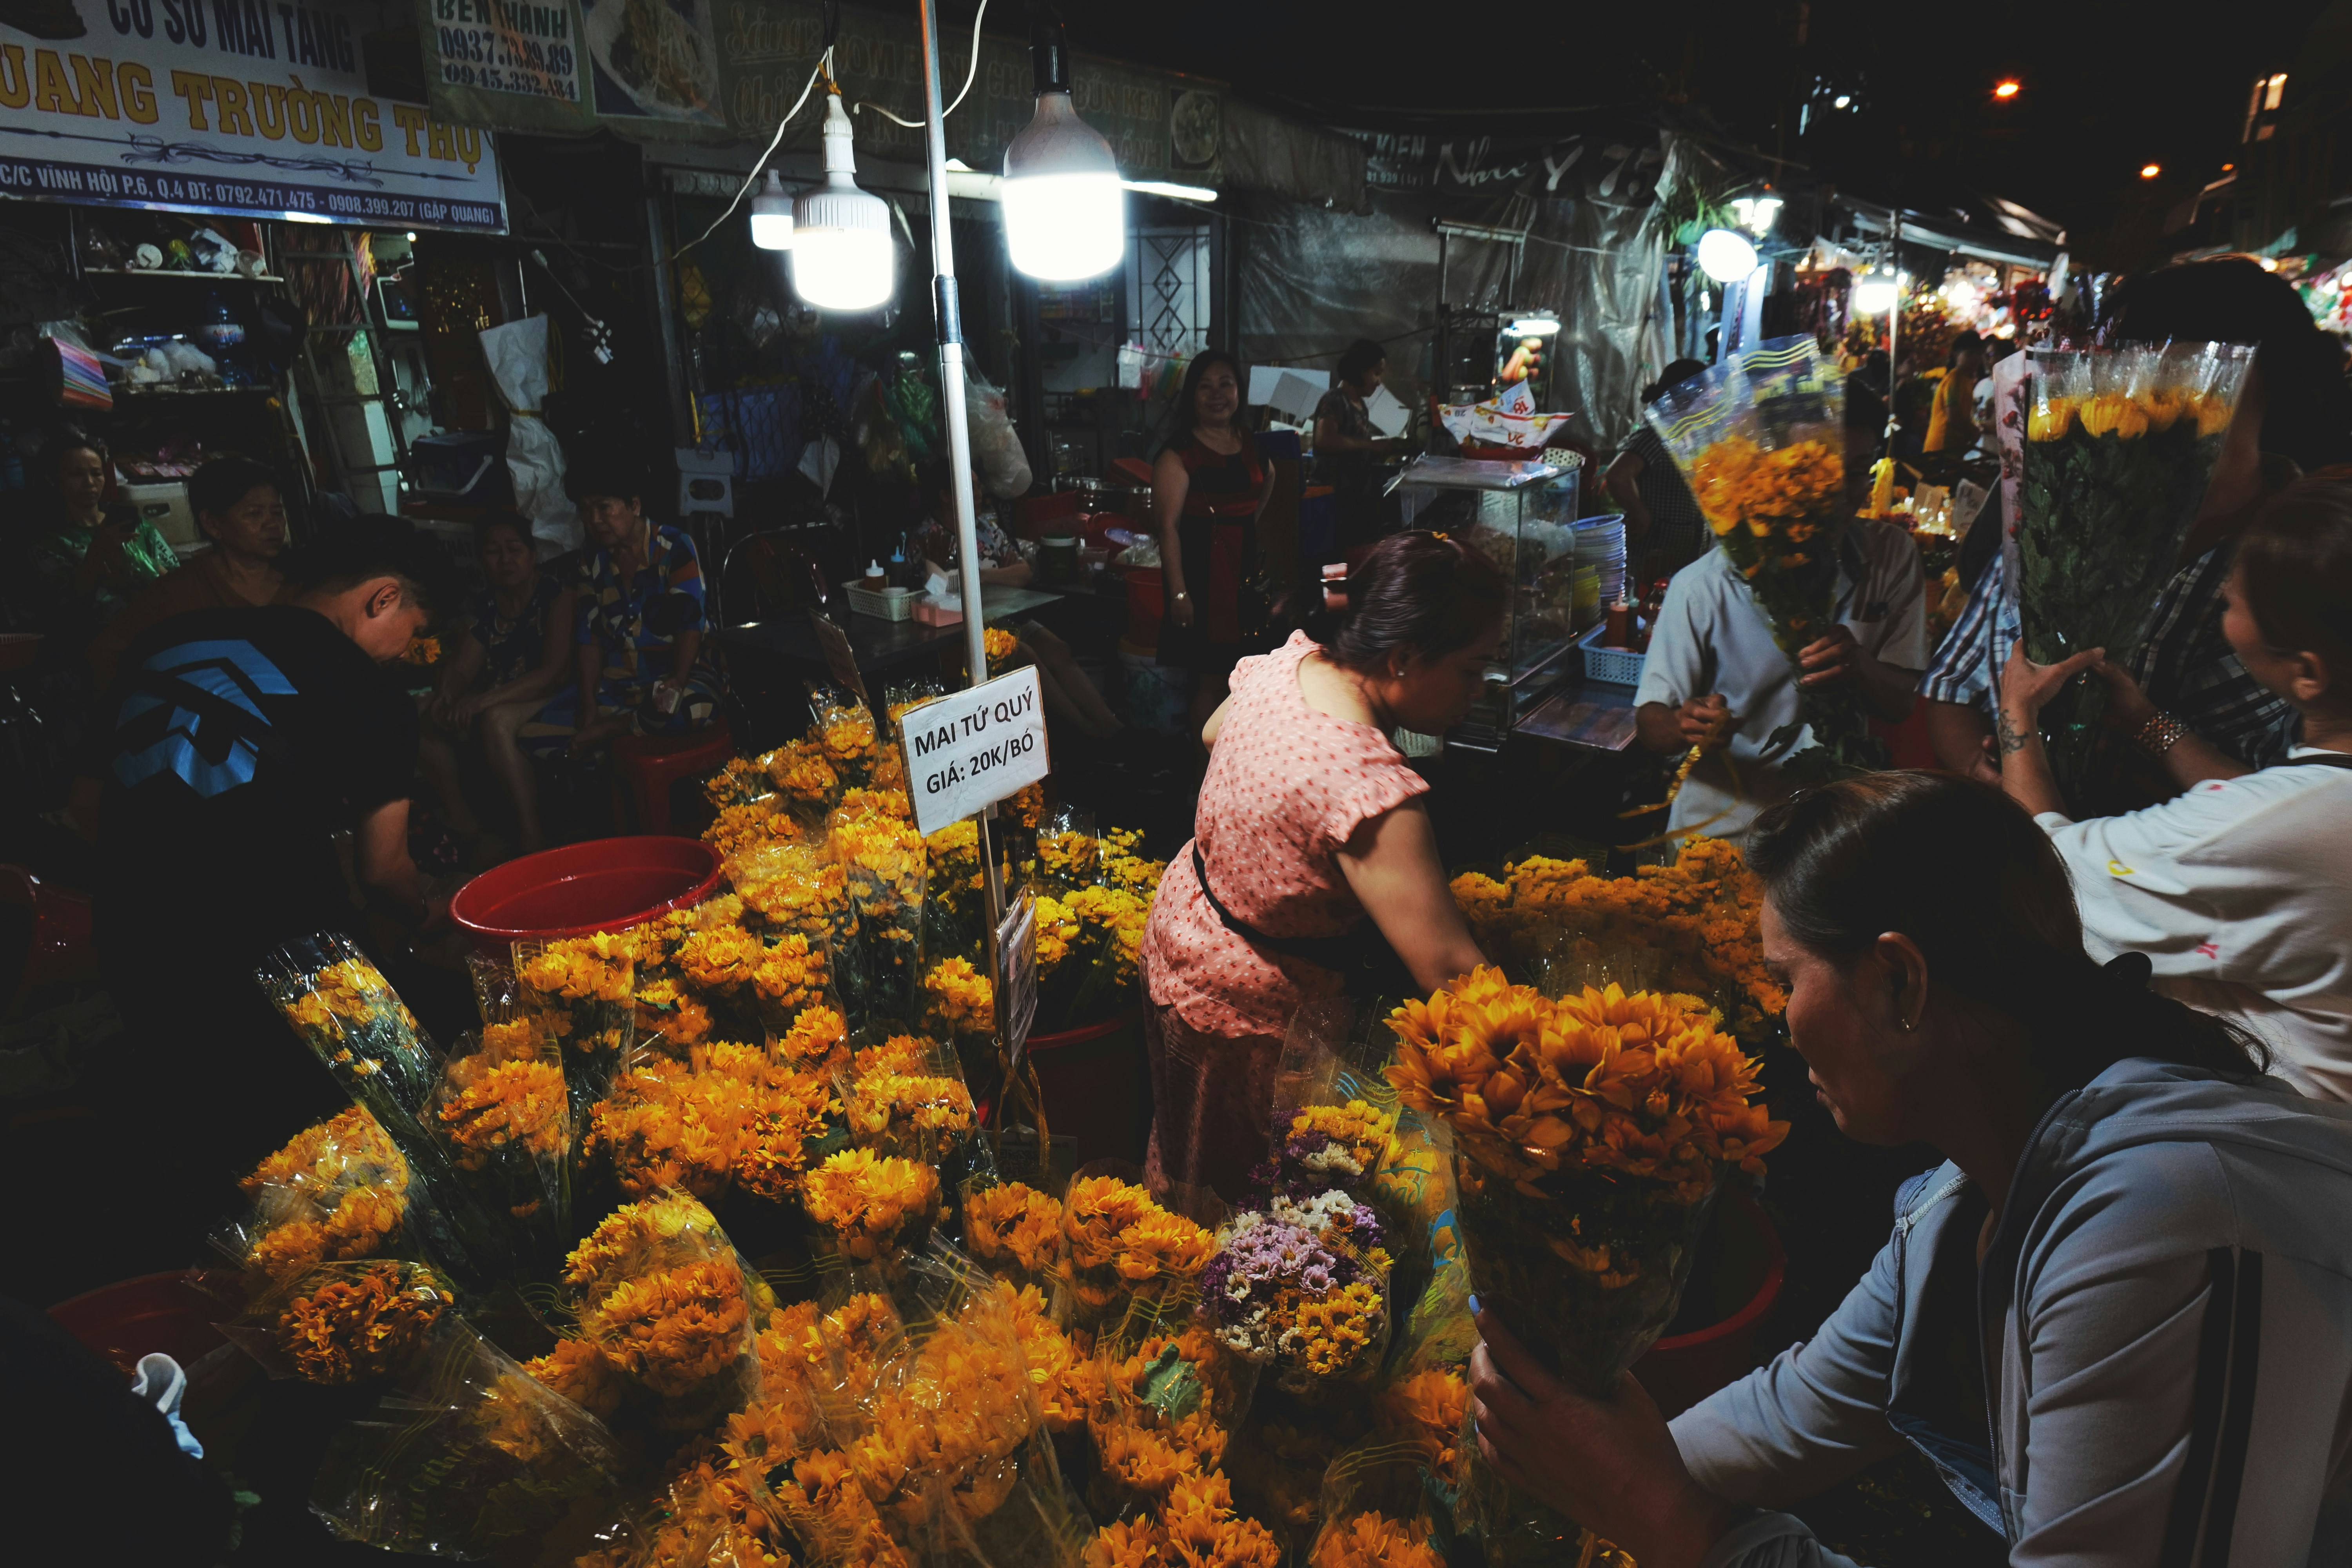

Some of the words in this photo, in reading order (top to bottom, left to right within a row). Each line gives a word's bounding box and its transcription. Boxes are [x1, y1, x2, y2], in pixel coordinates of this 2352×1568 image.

[213, 0, 276, 59] MAI
[277, 0, 356, 73] TÁNG
[440, 26, 573, 76] 0937.73.89.89
[0, 44, 159, 124] UANG
[171, 70, 383, 152] TRƯỜNG
[37, 164, 82, 191] VĨNH
[87, 169, 118, 197] HỘI
[122, 175, 153, 198] P.6,
[158, 179, 184, 200] Q.4
[188, 181, 211, 202] ĐT:
[216, 183, 315, 208] 0792.471.475
[328, 194, 415, 217] 0908.399.207
[451, 207, 494, 225] QUANG)
[915, 722, 956, 757] MAI
[960, 705, 989, 737] TỨ
[995, 686, 1033, 723] QUÝ
[926, 760, 965, 794] GIÁ:
[969, 728, 1034, 777] 20K/BÓ
